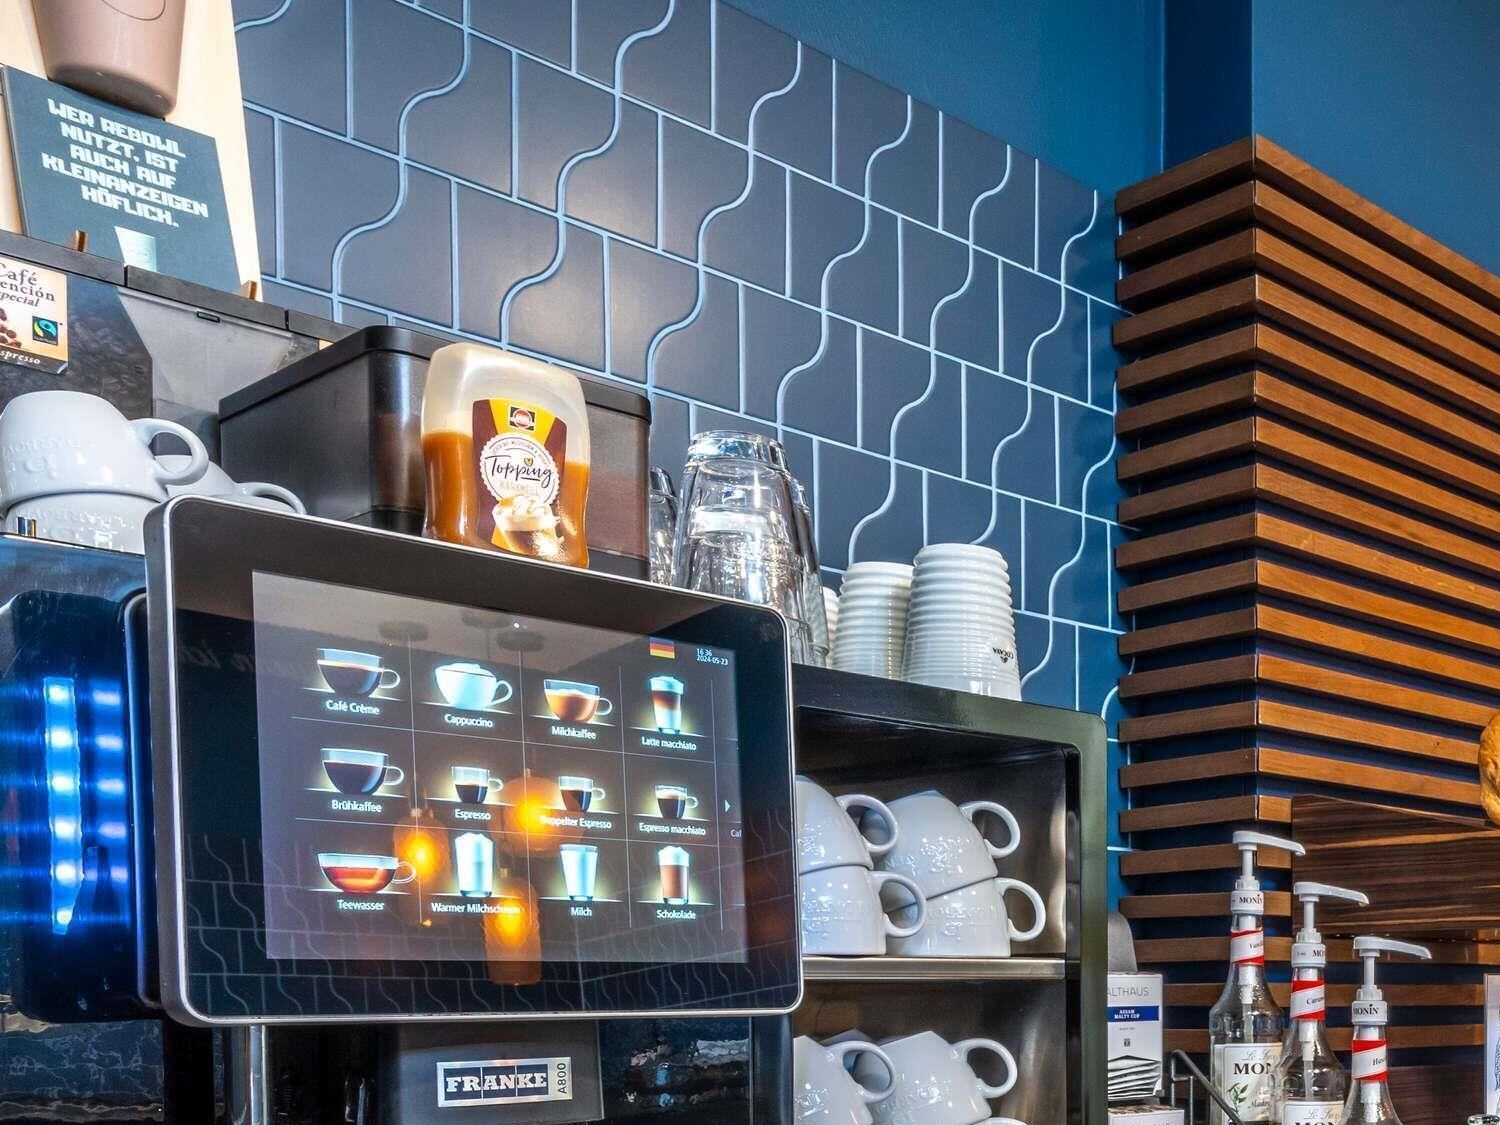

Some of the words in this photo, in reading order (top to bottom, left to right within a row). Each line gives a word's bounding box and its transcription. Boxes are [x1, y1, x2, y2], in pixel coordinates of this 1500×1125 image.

[47, 98, 95, 128] WER
[100, 116, 187, 158] REBOWL
[70, 143, 130, 176] AUCH
[136, 165, 177, 190] AUF
[145, 149, 179, 172] IST
[41, 152, 209, 218] KLEINANZEIGEN
[80, 184, 179, 228] HÖFLICH.
[0, 290, 40, 307] pecial
[484, 454, 553, 489] Topping
[326, 700, 348, 712] Café
[349, 702, 380, 715] Crème
[444, 713, 493, 728] Cappuccino
[551, 725, 597, 740] Milchkaffee
[641, 736, 660, 748] Latte
[661, 738, 697, 751] macchiato
[331, 799, 382, 813] Brühkaffee
[454, 808, 492, 821] Espresso
[581, 817, 612, 830] Espresso
[639, 822, 670, 834] Espresso
[670, 824, 706, 836] macchiato
[336, 899, 385, 911] Teewasser
[431, 902, 466, 913] Warmer
[571, 906, 592, 917] Milch
[656, 909, 696, 920] Schokolade
[446, 1071, 548, 1092] FRANKE
[556, 1062, 567, 1095] A800
